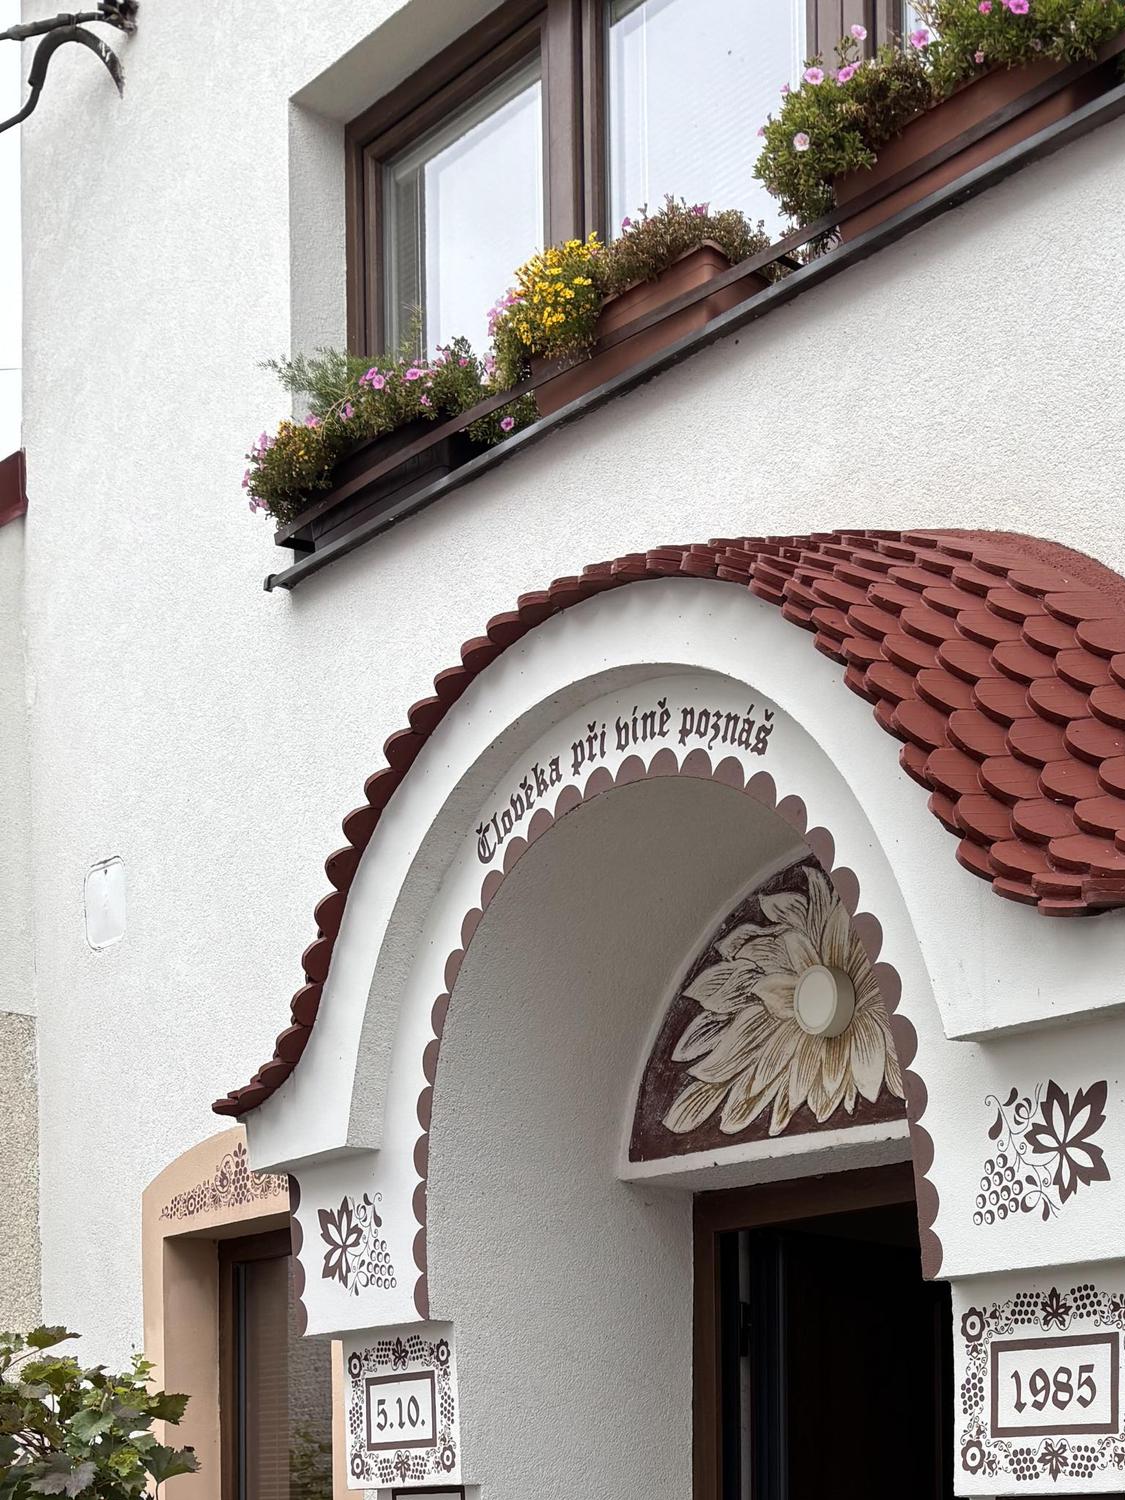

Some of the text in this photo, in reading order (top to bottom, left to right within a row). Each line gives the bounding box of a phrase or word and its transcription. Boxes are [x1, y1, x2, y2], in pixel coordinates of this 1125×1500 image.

[476, 697, 775, 864] Člověka při víně poznáš
[1010, 1363, 1097, 1413] 1985
